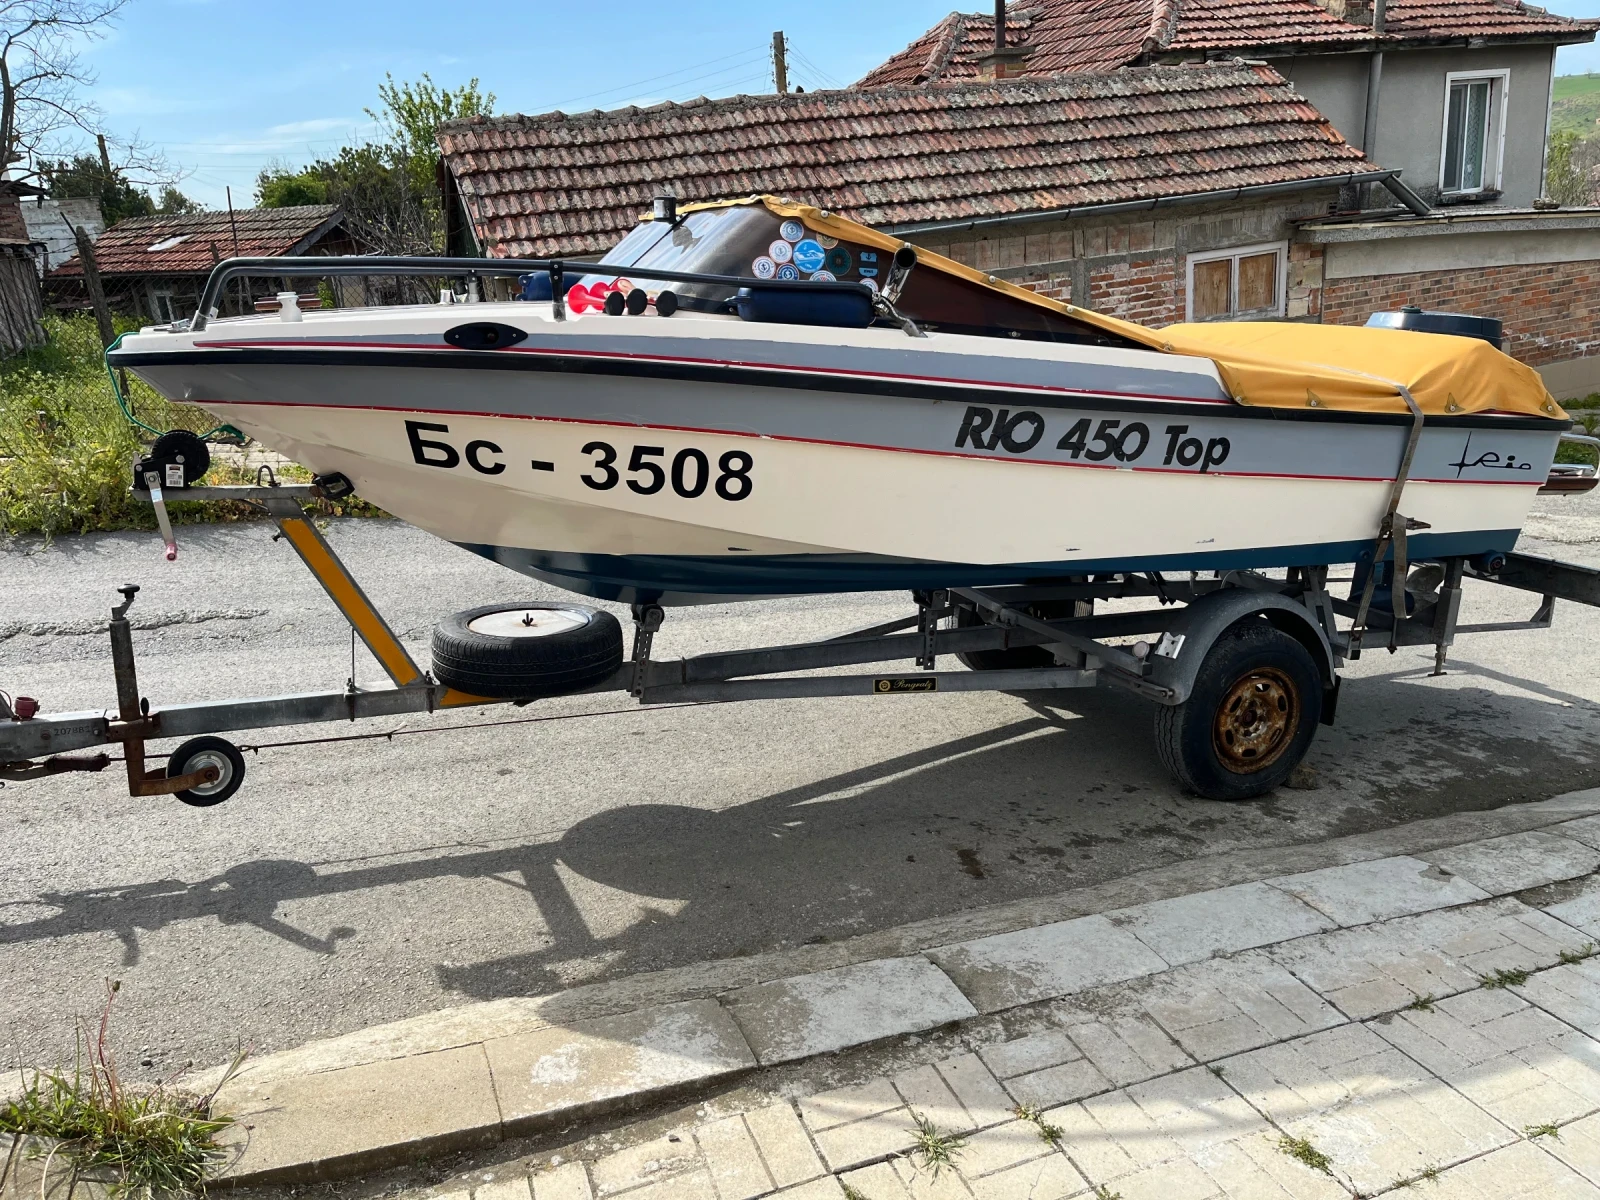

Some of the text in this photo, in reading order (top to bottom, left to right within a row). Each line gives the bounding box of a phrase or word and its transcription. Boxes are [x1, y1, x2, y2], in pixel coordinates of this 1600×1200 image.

[404, 420, 507, 475] Бс
[579, 441, 754, 502] 3508
[954, 406, 1231, 475] RIO 450 Top
